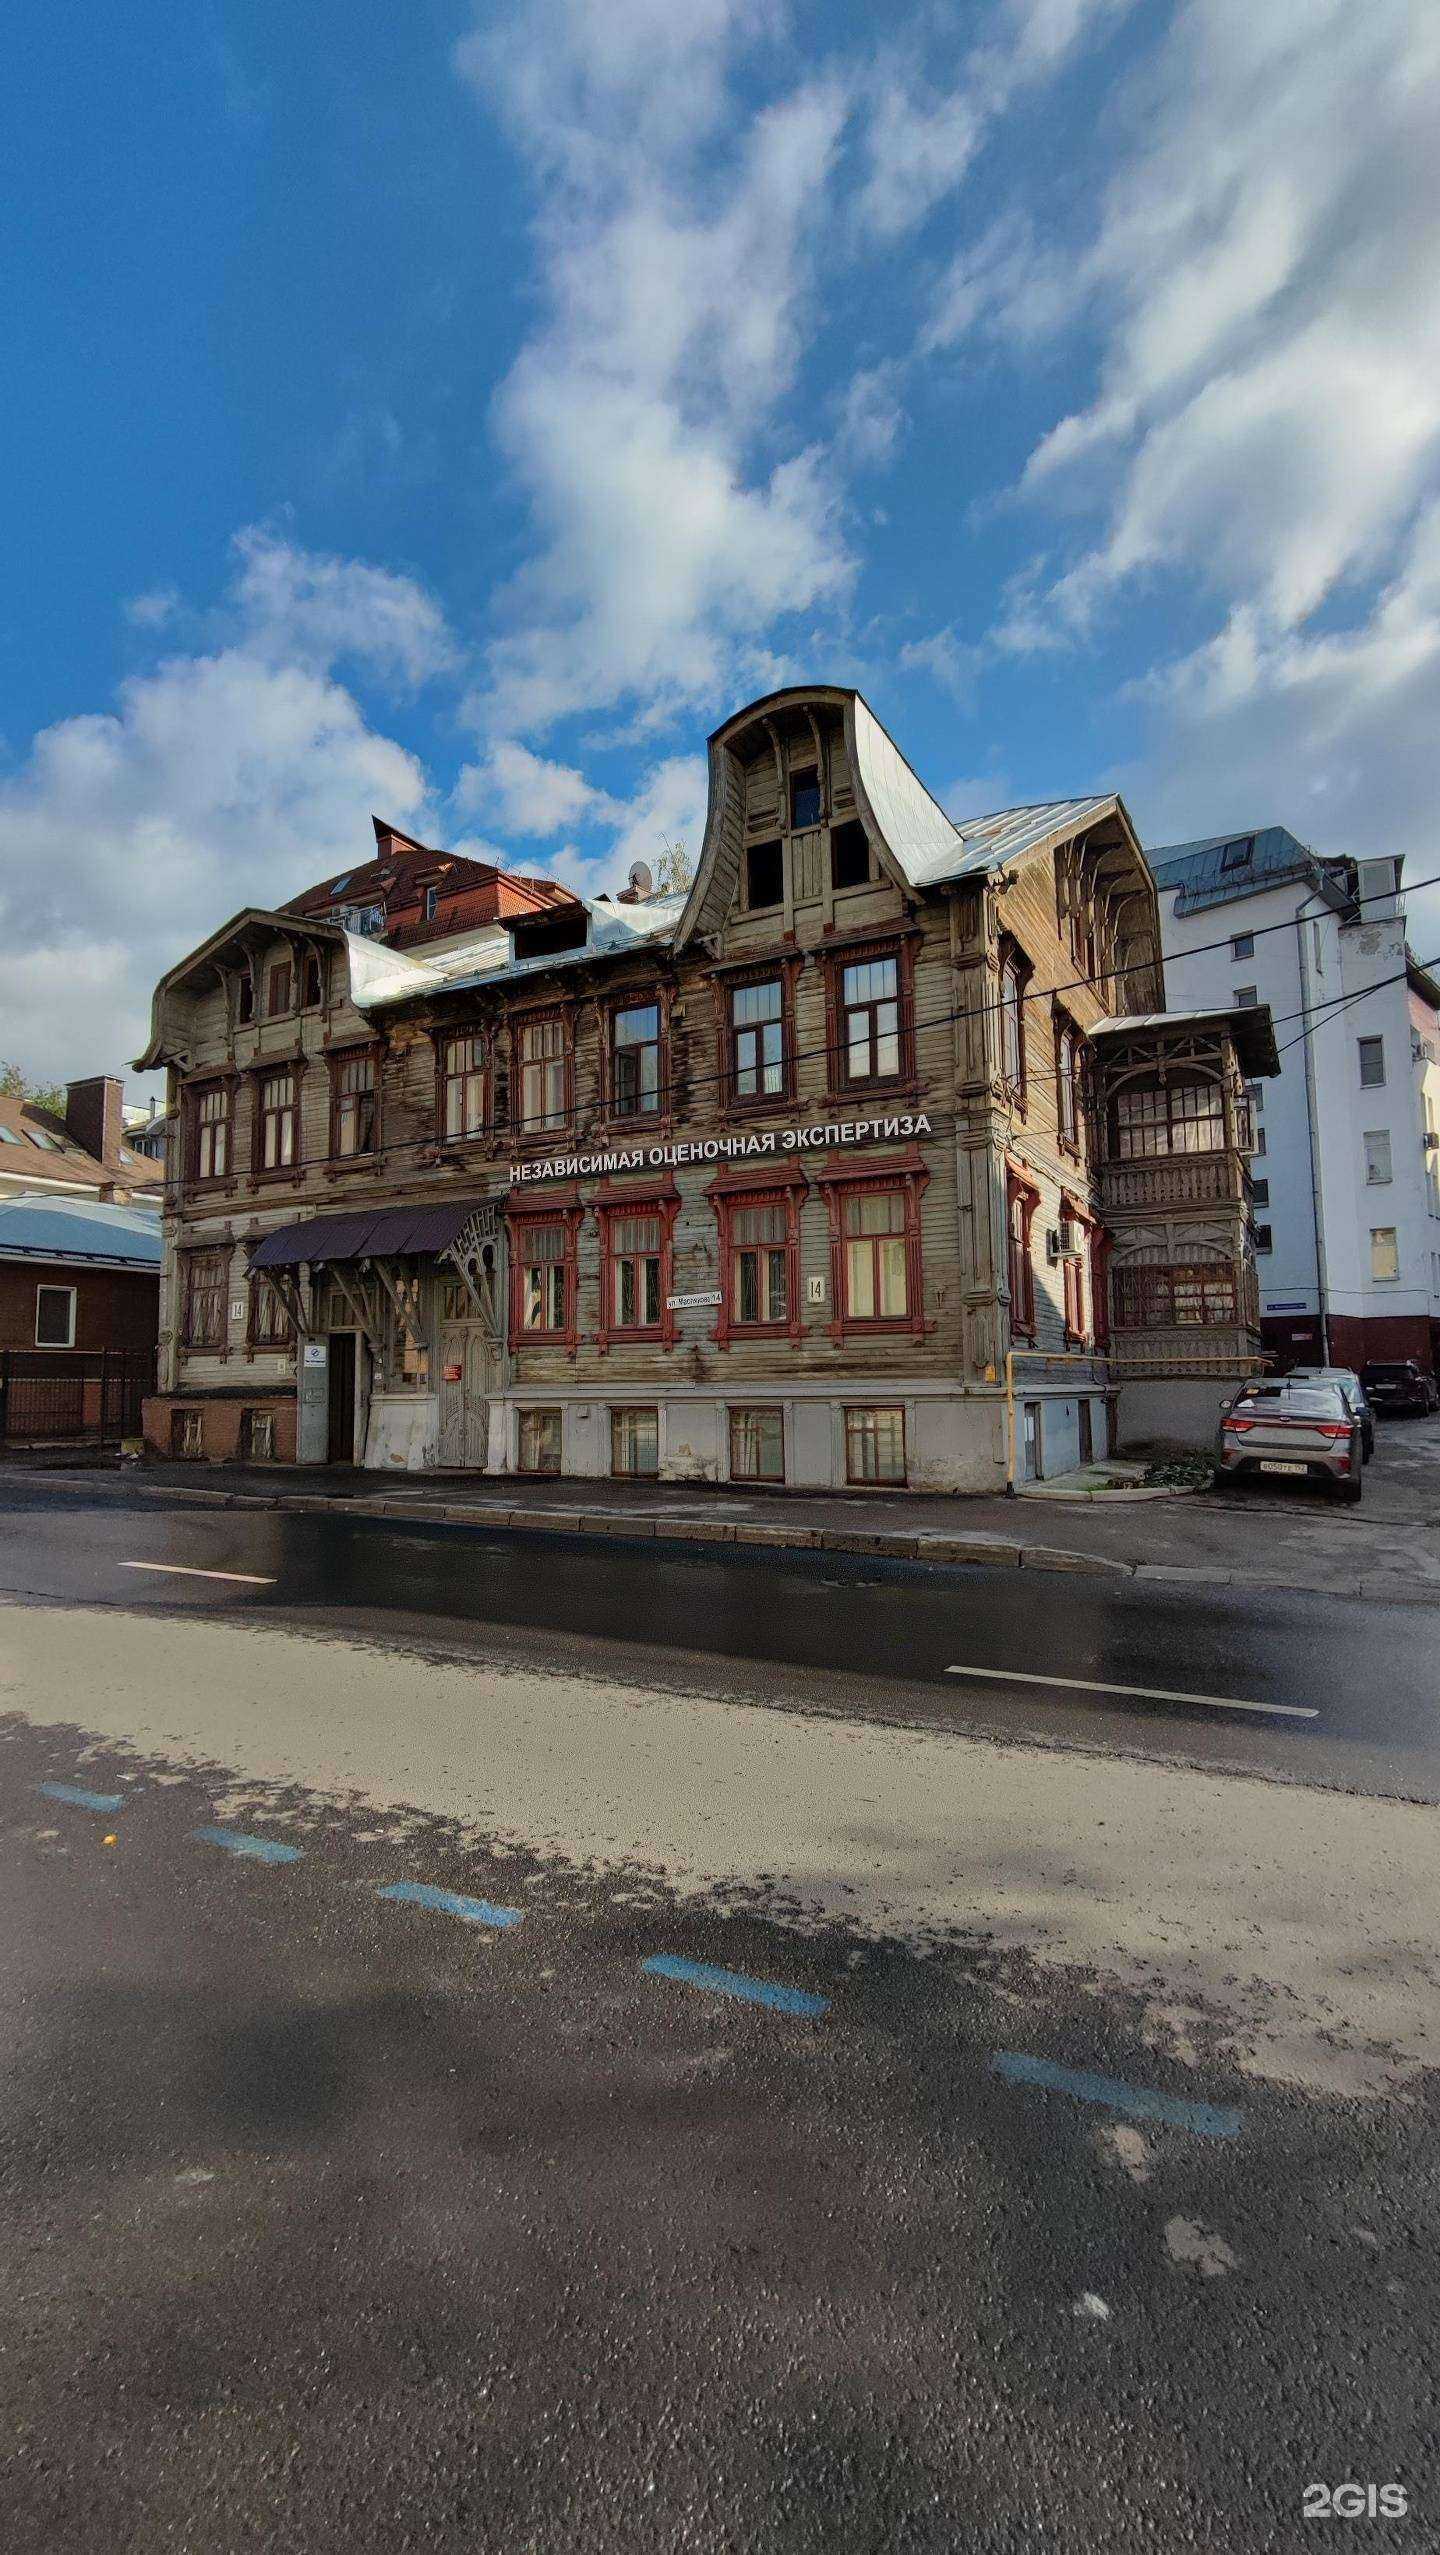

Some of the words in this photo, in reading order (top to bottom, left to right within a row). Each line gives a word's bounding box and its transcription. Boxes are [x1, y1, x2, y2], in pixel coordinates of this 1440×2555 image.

[509, 1150, 644, 1182] НЕЗАВИСИМАЯ
[649, 1133, 775, 1166] ОЦЕНОЧНАЯ
[781, 1114, 932, 1148] ЭКСПЕРТИЗА
[810, 1280, 821, 1298] 14
